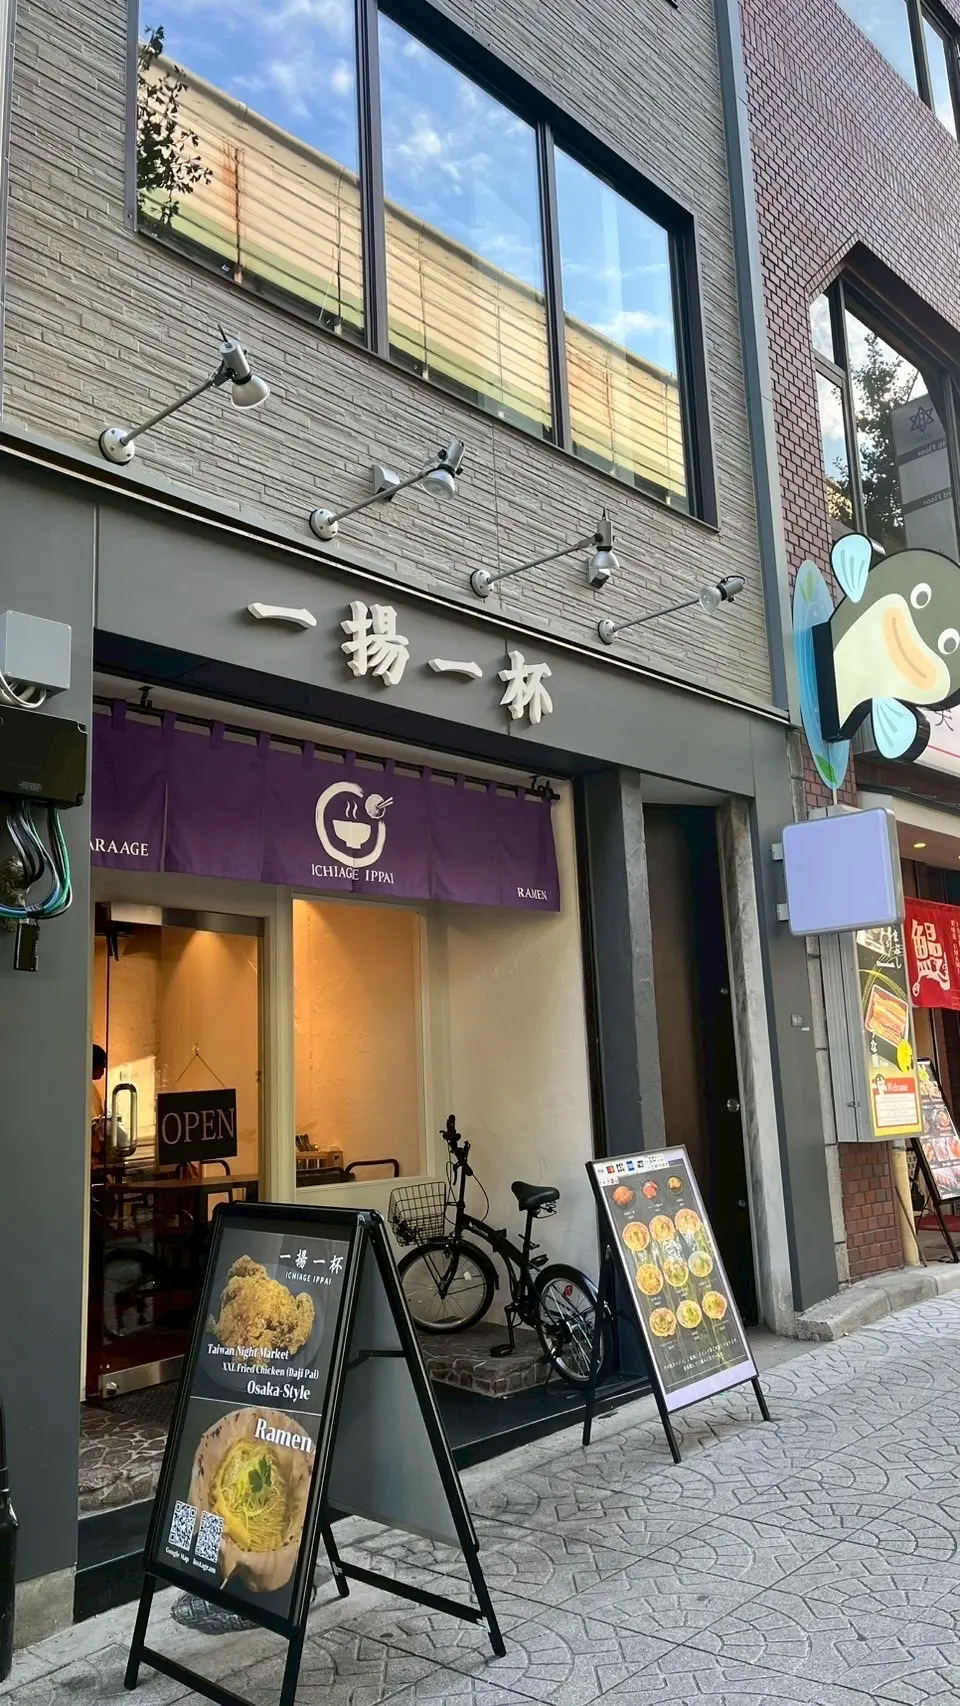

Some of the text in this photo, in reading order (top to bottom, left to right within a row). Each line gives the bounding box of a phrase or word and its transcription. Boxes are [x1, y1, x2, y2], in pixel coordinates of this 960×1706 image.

[247, 600, 553, 725] 一揚一杯
[311, 863, 394, 884] ICHIAGE IPPAI
[517, 887, 547, 900] RAMEN
[161, 1108, 235, 1145] OPEN
[279, 1249, 344, 1274] 一揚一杯
[285, 1271, 332, 1285] ICHIAGE IPPAI
[207, 1343, 289, 1360] Taiwan Night Market
[222, 1362, 320, 1380] XXL Fried Chicken (Daji Pai)
[247, 1380, 311, 1402] Osaka-Style
[254, 1418, 312, 1453] Ramen
[165, 1546, 217, 1574] Google Map Instagram
